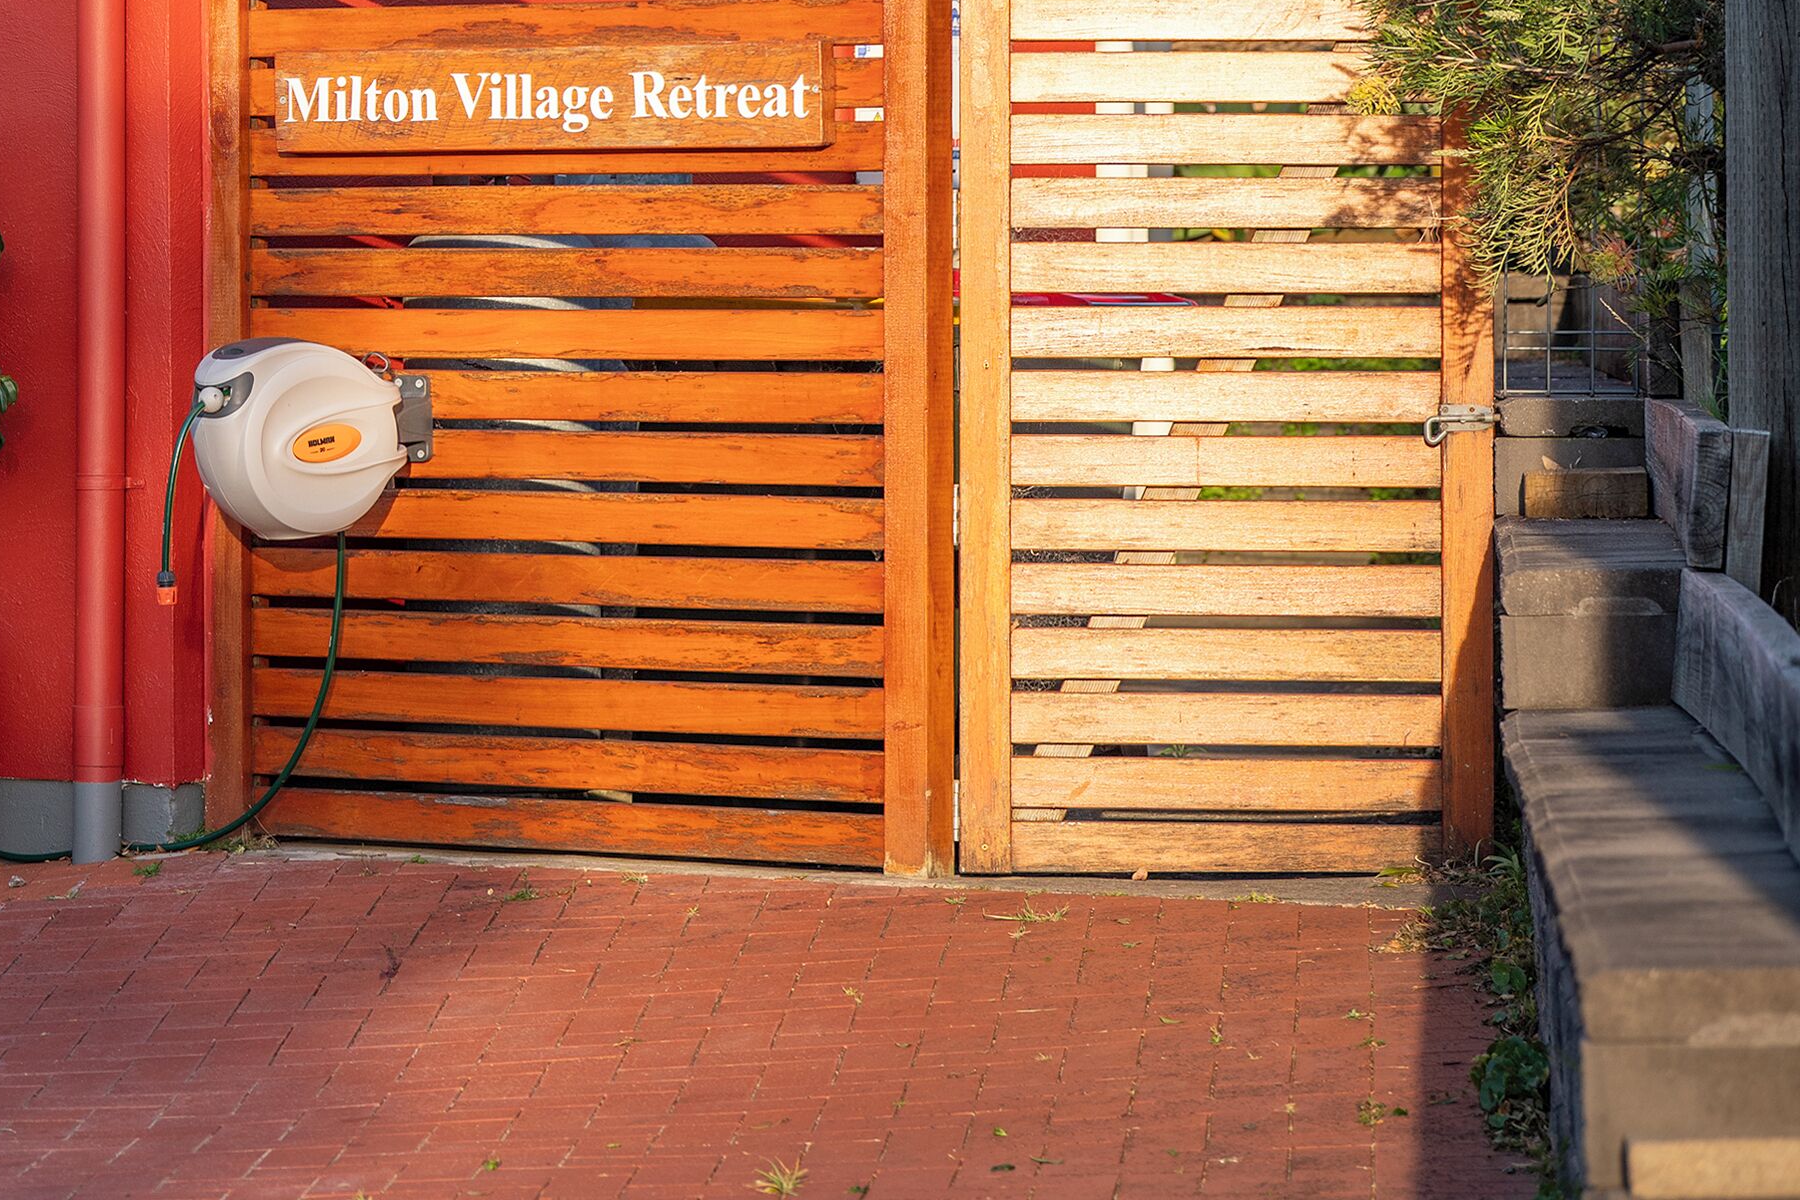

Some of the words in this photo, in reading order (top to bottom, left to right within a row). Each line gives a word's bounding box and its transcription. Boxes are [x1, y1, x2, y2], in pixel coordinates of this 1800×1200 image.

[283, 75, 439, 123] Milton
[450, 72, 615, 132] Village
[628, 70, 811, 119] Retreat
